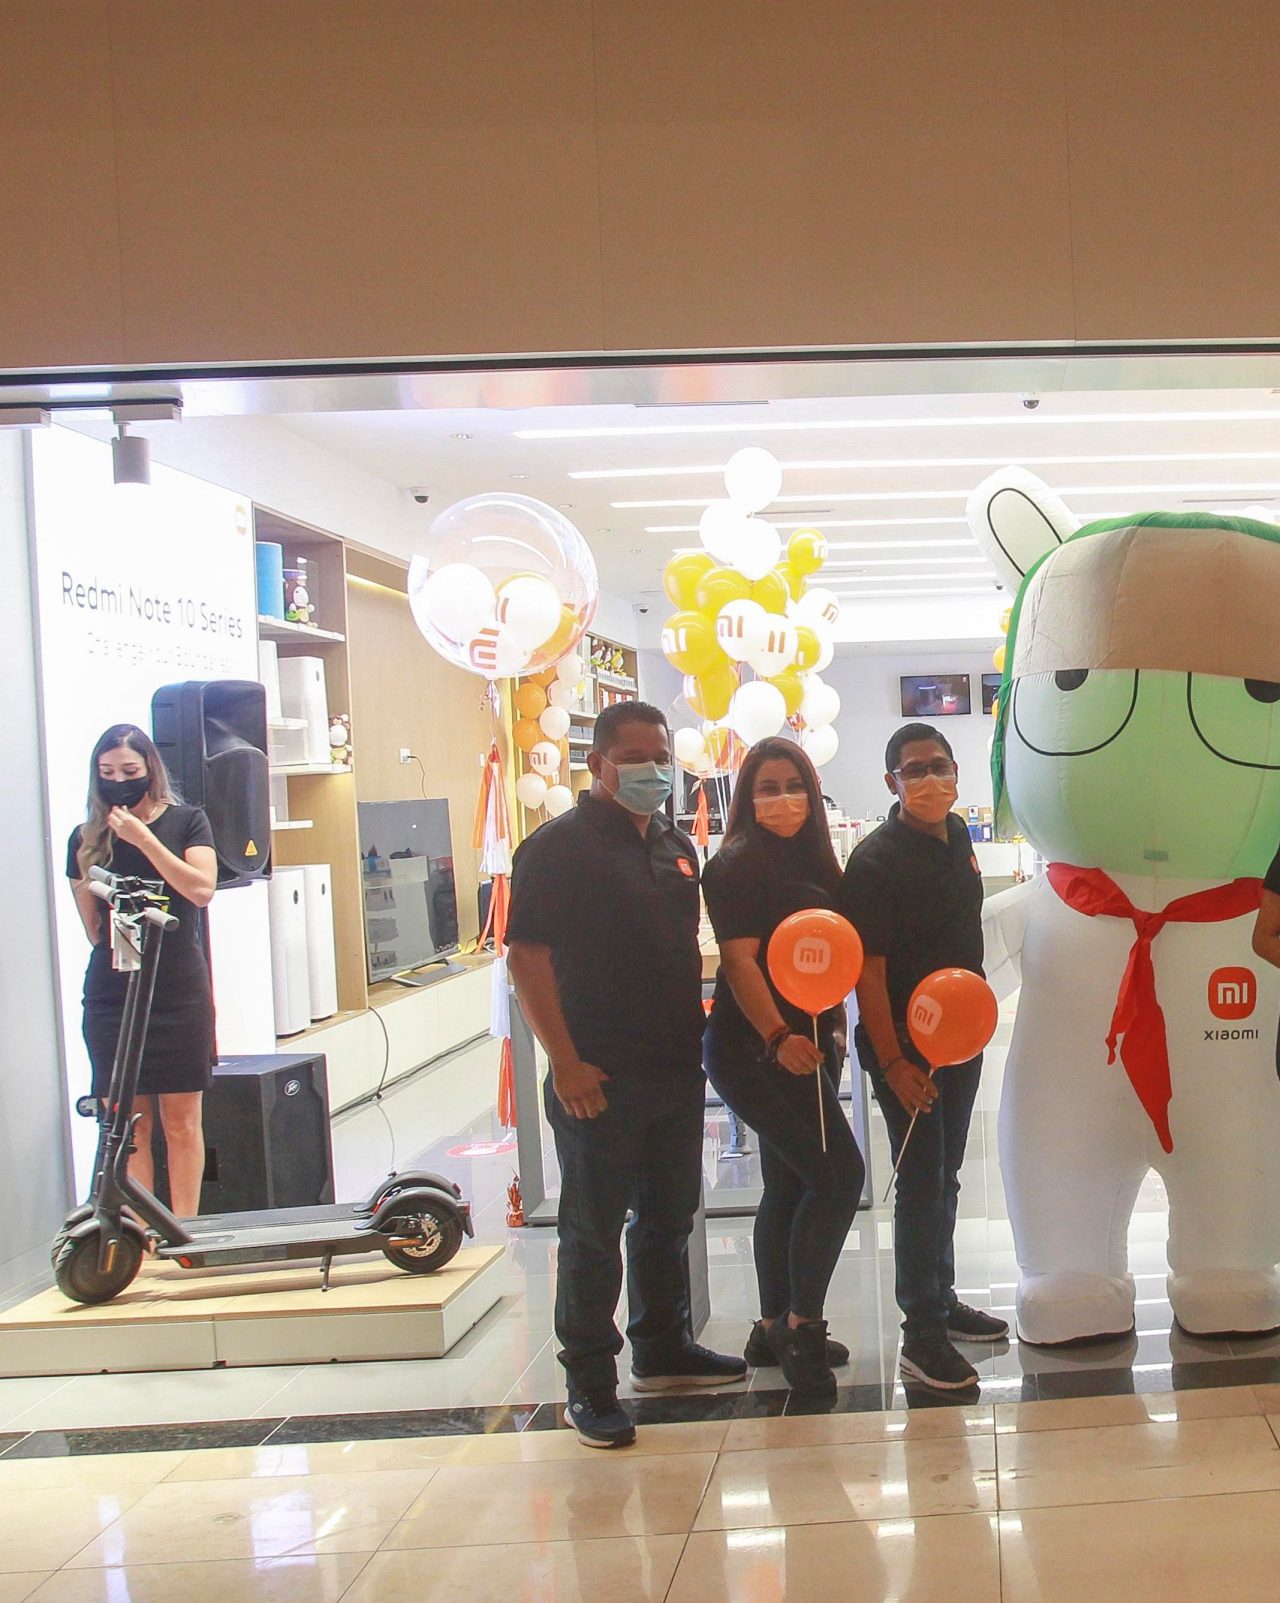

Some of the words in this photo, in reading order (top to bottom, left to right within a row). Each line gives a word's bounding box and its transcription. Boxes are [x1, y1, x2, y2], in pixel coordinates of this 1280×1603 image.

[62, 570, 123, 615] Redmi
[129, 585, 171, 624] Note
[177, 598, 196, 628] 10
[200, 602, 243, 639] Series
